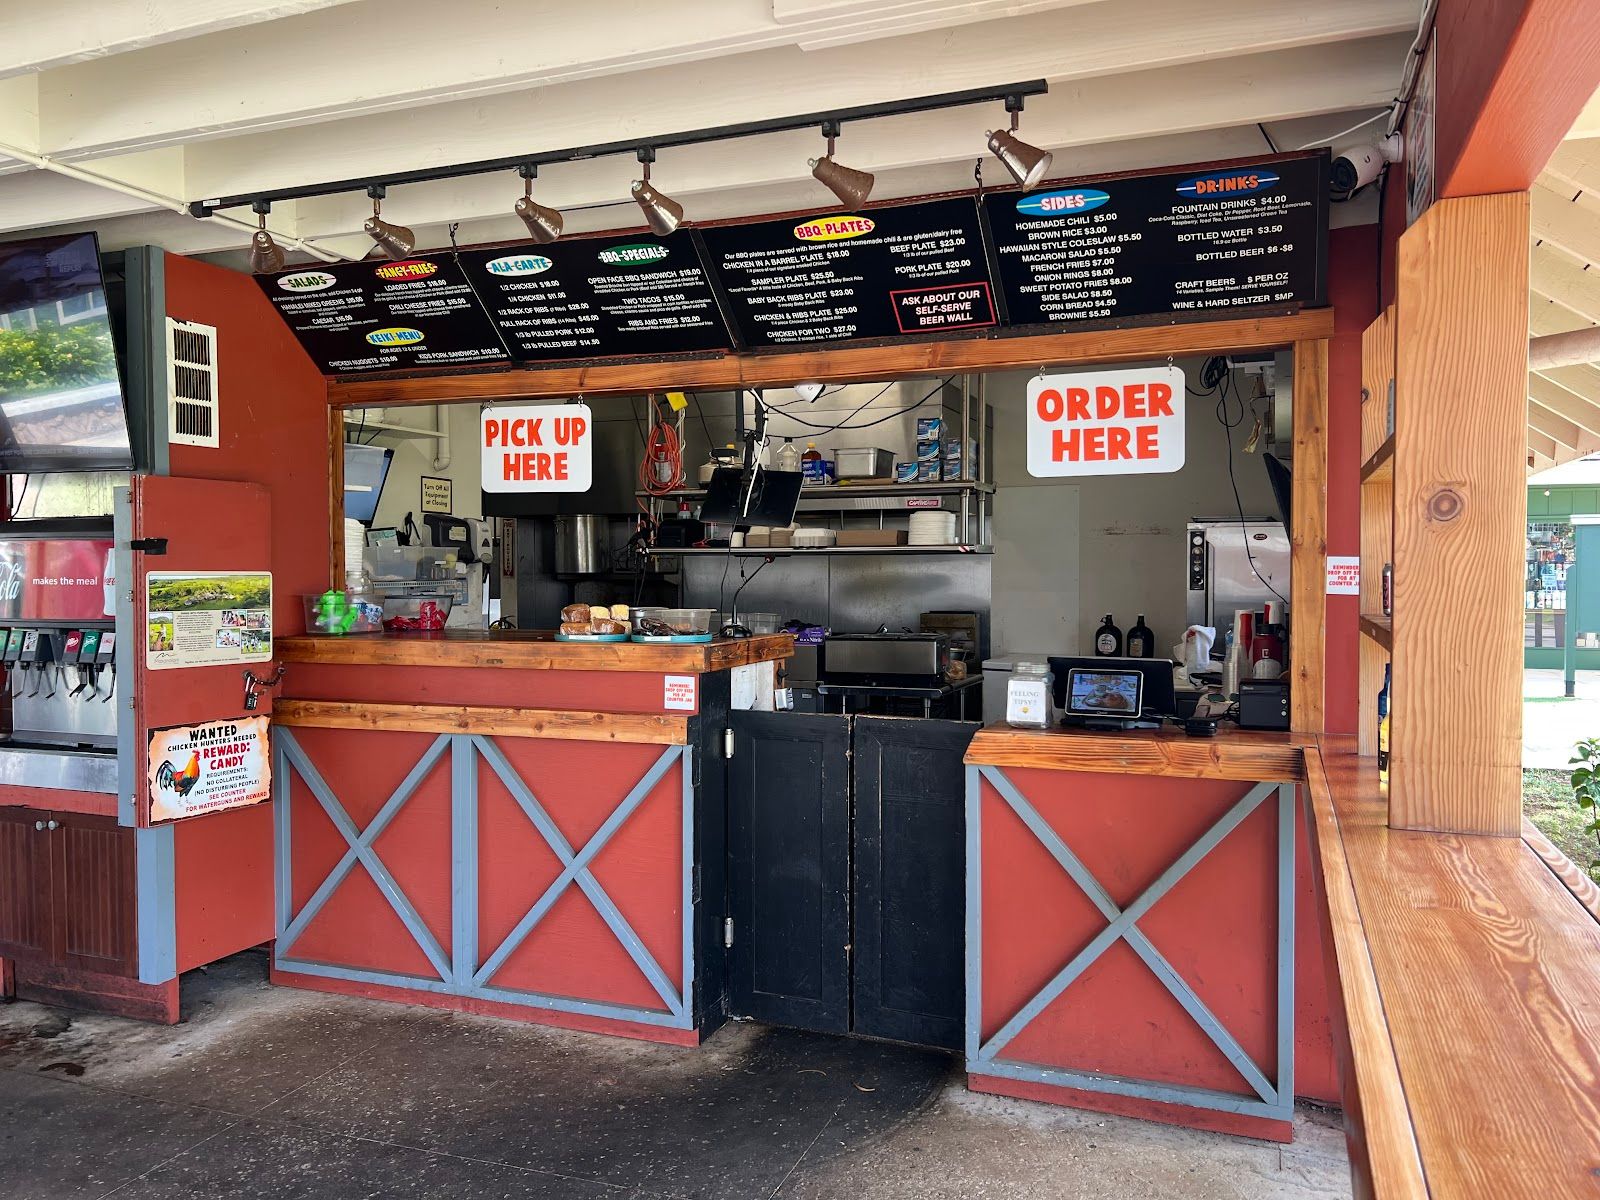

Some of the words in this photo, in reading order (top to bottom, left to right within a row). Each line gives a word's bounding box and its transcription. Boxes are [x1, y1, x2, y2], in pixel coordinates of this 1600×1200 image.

[1196, 175, 1258, 194] DRINKS
[1040, 194, 1085, 211] SIDES
[1171, 202, 1218, 214] FOUNTAIN
[1220, 199, 1256, 210] DRINKS
[1260, 195, 1287, 205] $4.00
[1015, 219, 1066, 231] HOMEMADE
[1067, 216, 1090, 226] CHILI
[1093, 212, 1118, 223] $5.00
[1028, 230, 1060, 241] BROWN
[1062, 228, 1083, 237] RICE
[1084, 225, 1108, 235] $3.00
[1177, 231, 1219, 242] BOTTLED
[1221, 228, 1254, 239] WATER
[1257, 224, 1283, 235] $3.50
[890, 244, 910, 253] BEEF
[912, 241, 937, 250] PLATE
[940, 237, 966, 247] $23.00
[1000, 243, 1040, 254] HAWAIIAN
[1041, 240, 1068, 251] STYLE
[1069, 235, 1116, 248] COLESLAW
[1118, 232, 1142, 243] $5.50
[722, 260, 755, 270] CHICKEN
[755, 259, 764, 267] IN
[771, 256, 800, 265] BARREL
[800, 253, 824, 262] PLATE
[826, 250, 850, 260] $18.00
[1022, 252, 1066, 263] MACARONI
[1068, 249, 1096, 259] SALAD
[1097, 245, 1122, 255] $5.50
[1196, 250, 1237, 261] BOTTLED
[1239, 248, 1264, 258] BEER
[895, 265, 917, 274] PORK
[918, 262, 942, 272] PLATE
[945, 259, 971, 269] $20.00
[1030, 262, 1065, 272] FRENCH
[1066, 259, 1091, 270] FRIES
[1092, 257, 1115, 267] $7.00
[288, 275, 327, 288] SALADS
[607, 275, 625, 283] FACE
[625, 274, 640, 282] BBQ
[640, 271, 677, 280] SANDWICH
[751, 276, 785, 286] SAMPLER
[785, 274, 808, 283] PLATE
[811, 271, 834, 280] $25.50
[1034, 273, 1062, 282] ONION
[1063, 271, 1090, 280] RINGS
[1091, 268, 1114, 277] $8.00
[1255, 274, 1273, 282] PER
[1275, 272, 1289, 281] OZ
[510, 282, 538, 291] CHICKEN
[1020, 284, 1048, 293] SWEET
[1050, 281, 1082, 291] POTATO
[1084, 279, 1108, 288] FRIES
[1175, 280, 1204, 289] CRAFT
[1206, 278, 1236, 287] BEERS
[638, 296, 661, 304] TACOS
[747, 296, 765, 305] BABY
[766, 295, 787, 303] BACK
[787, 293, 804, 302] RIBS
[805, 291, 827, 299] PLATE
[830, 288, 854, 297] $23.00
[902, 296, 921, 306] ASK
[922, 292, 956, 304] ABOUT
[958, 290, 980, 300] OUR
[1041, 293, 1060, 302] SIDE
[1062, 291, 1089, 300] SALAD
[1172, 301, 1195, 310] WINE
[1196, 300, 1203, 308] &
[1205, 298, 1230, 307] HARD
[1231, 295, 1270, 305] SELTZER
[916, 302, 971, 315] SELF-SERVE
[1040, 302, 1064, 311] CORN
[1065, 300, 1093, 310] BREAD
[1094, 298, 1117, 307] $4.50
[753, 313, 785, 322] CHICKEN
[792, 311, 809, 319] RIBS
[809, 308, 832, 317] PLATE
[834, 306, 858, 315] $25.00
[920, 315, 944, 325] BEER
[947, 312, 973, 323] WALL
[1049, 311, 1087, 321] BROWNIE
[1088, 309, 1111, 318] $5.50
[766, 330, 797, 339] CHICKEN
[813, 327, 830, 335] TWO
[833, 325, 857, 333] $27.00
[1037, 383, 1174, 422] ORDER
[485, 418, 543, 447] PICK
[554, 417, 586, 446] UP
[1051, 425, 1160, 463] HERE
[503, 453, 568, 481] HERE
[425, 492, 448, 500] Equipment
[0, 562, 21, 600] ola
[32, 577, 58, 585] makes
[60, 577, 74, 585] the
[76, 577, 98, 585] meal
[190, 724, 237, 741] WANTED
[168, 742, 198, 752] CHICKEN
[200, 738, 231, 747] HUNTERS
[233, 733, 257, 742] NEEDED
[203, 742, 251, 759] REWARD:
[210, 755, 244, 771] CANDY
[206, 767, 248, 778] REQUIREMENTS:
[215, 775, 248, 785] COLLATERAL
[194, 789, 205, 797] (NO
[205, 784, 238, 794] DISTURBING
[238, 779, 260, 788] PEOPLE)
[209, 793, 220, 801] SEE
[221, 789, 246, 798] COUNTER
[199, 800, 232, 810] WATERGUNS
[246, 791, 268, 800] REWARD
